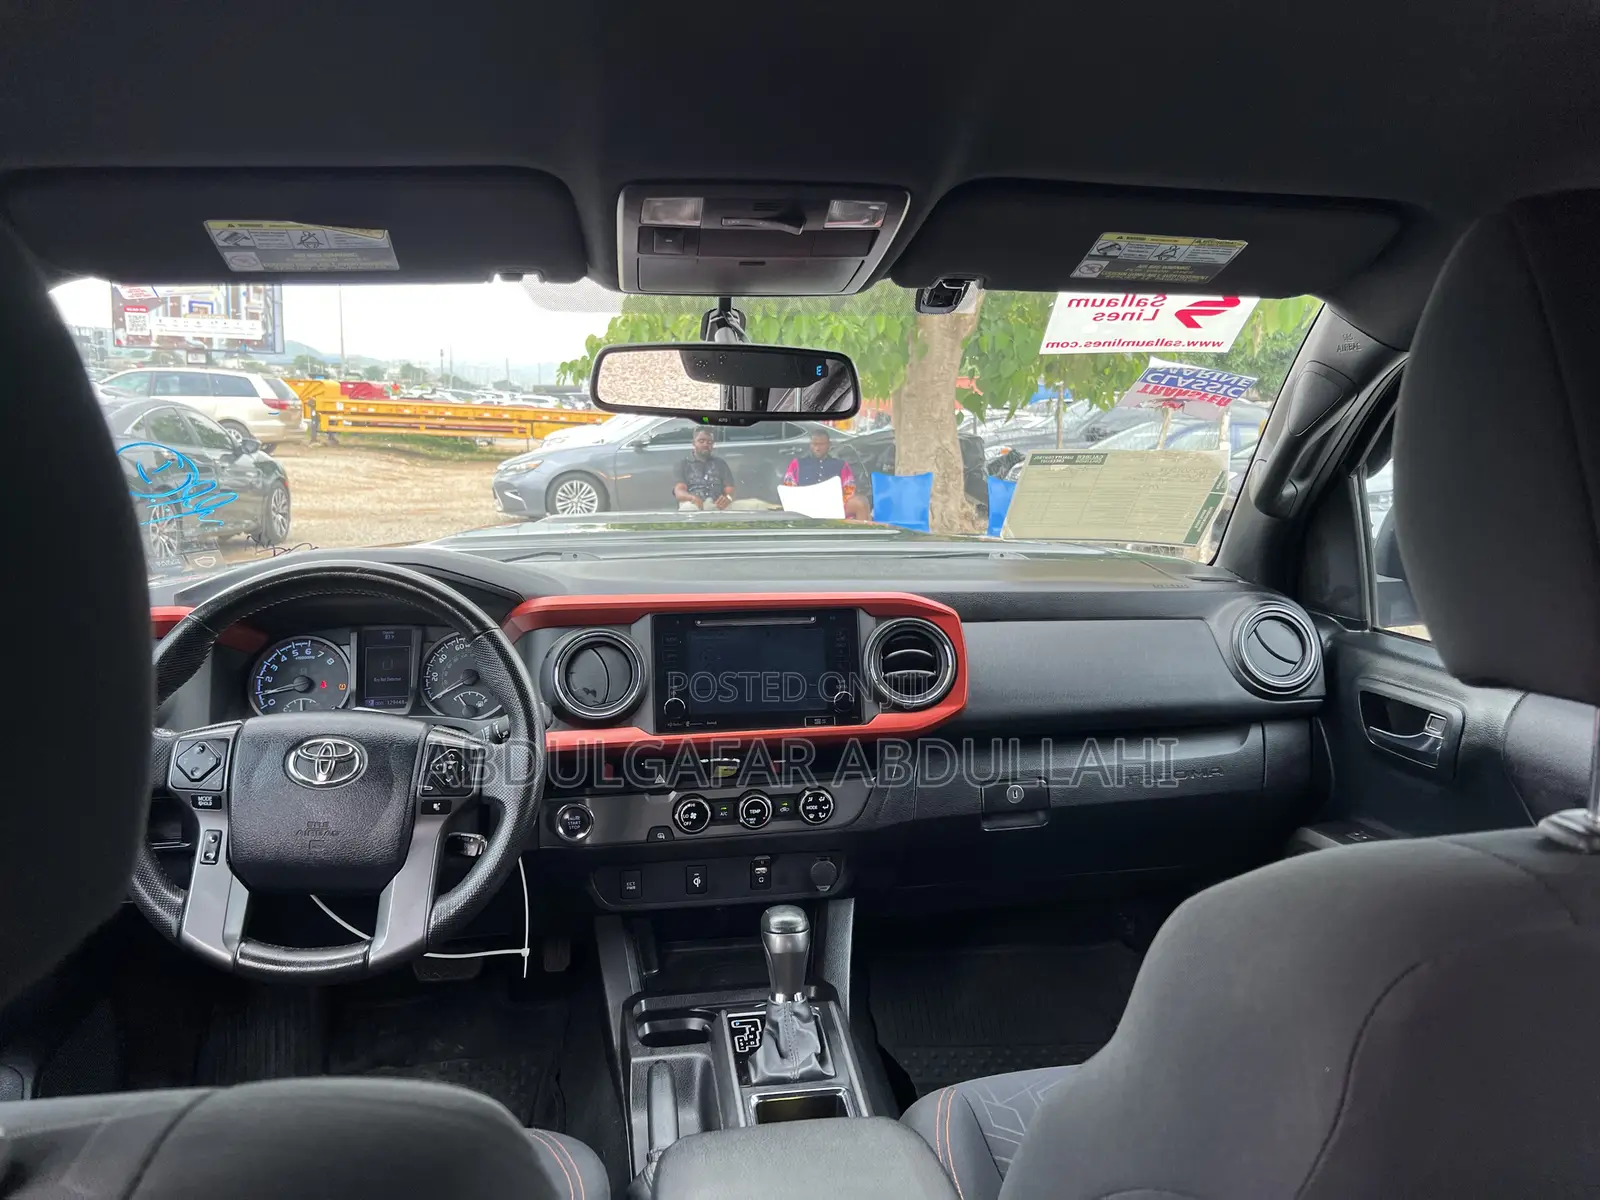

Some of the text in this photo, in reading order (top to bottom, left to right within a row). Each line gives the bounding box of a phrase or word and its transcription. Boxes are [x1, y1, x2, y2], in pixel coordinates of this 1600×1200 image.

[816, 365, 822, 376] E
[292, 649, 299, 657] 5
[280, 654, 288, 662] 4
[326, 658, 335, 666] 8
